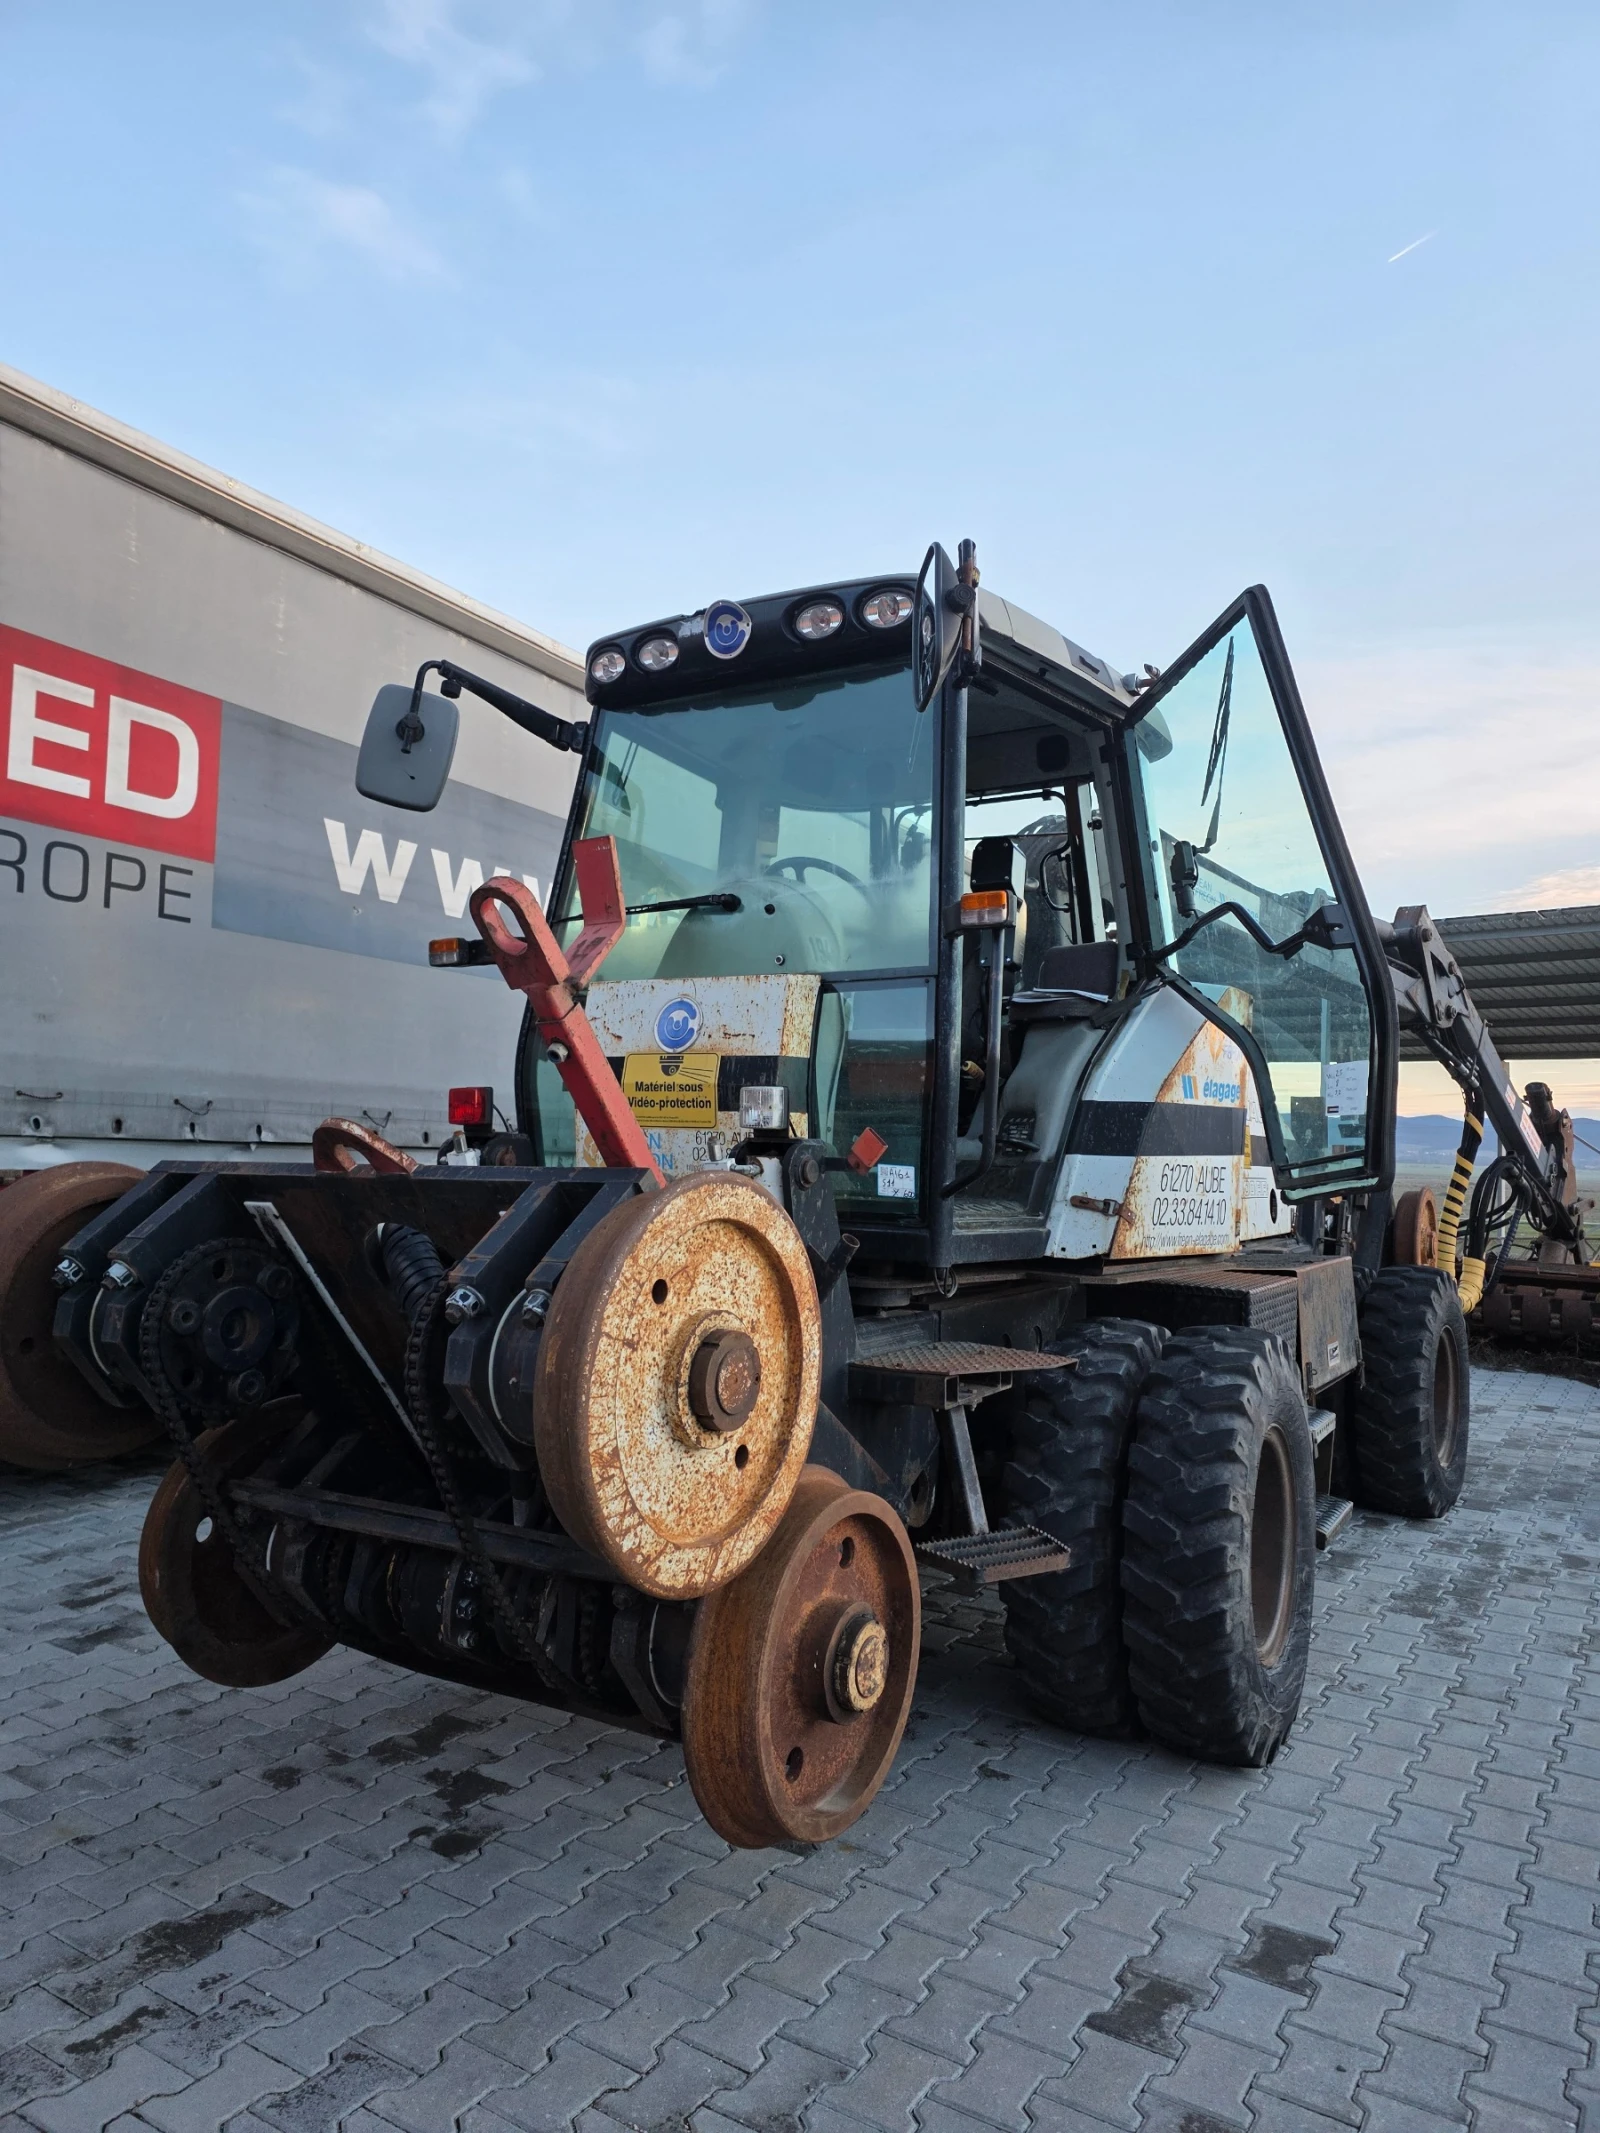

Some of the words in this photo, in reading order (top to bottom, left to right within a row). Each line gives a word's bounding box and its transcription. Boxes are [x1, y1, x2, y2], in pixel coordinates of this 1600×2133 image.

[635, 1081, 675, 1092] Matériel
[679, 1083, 703, 1092] sous
[1203, 1076, 1241, 1103] élagage
[628, 1096, 711, 1111] Vidéo-protection
[1160, 1163, 1194, 1192] 61270
[1196, 1166, 1226, 1193] AUBE
[1152, 1197, 1226, 1226] 02.33.84.14.10
